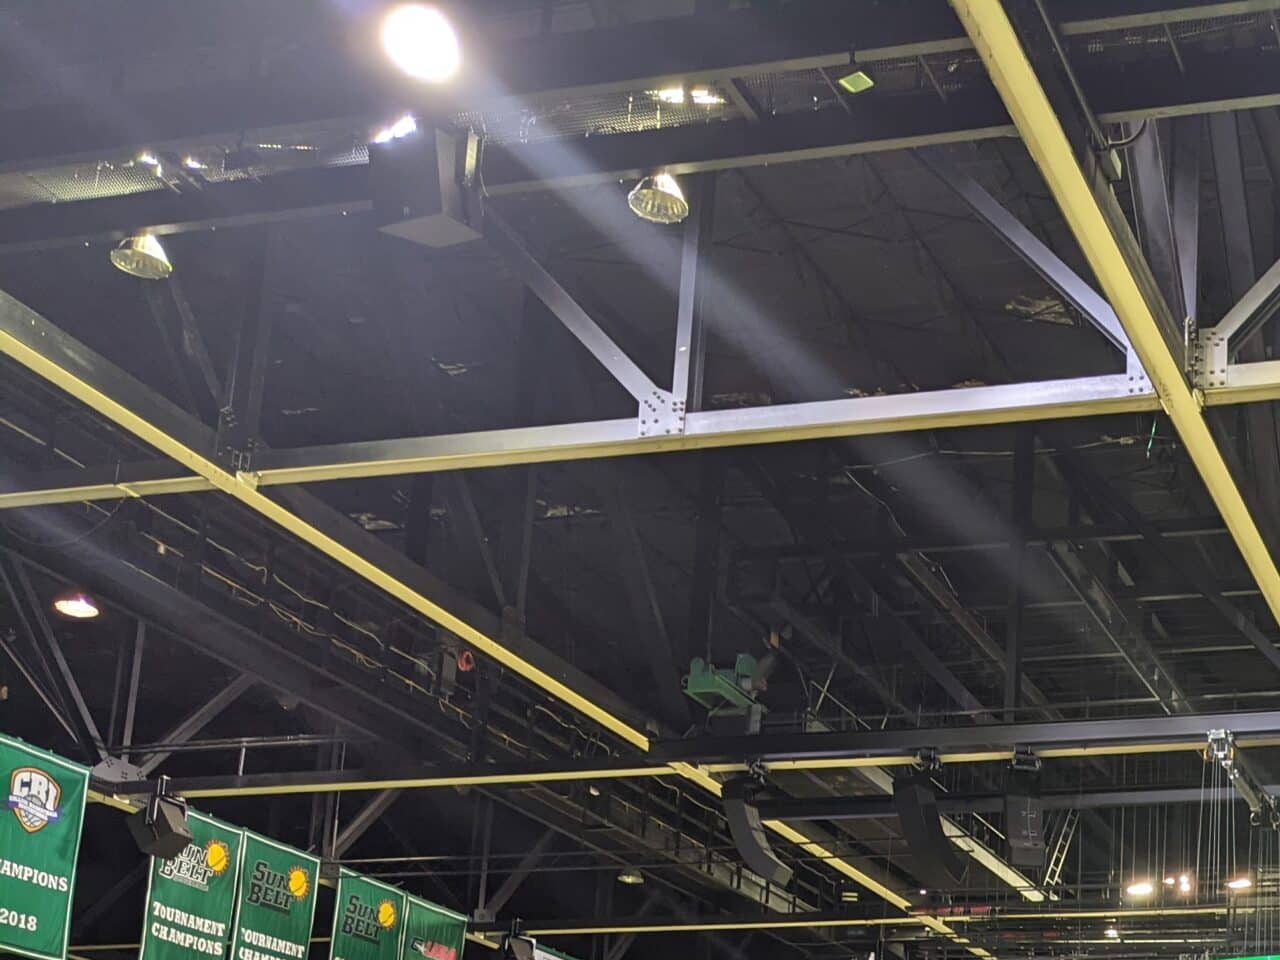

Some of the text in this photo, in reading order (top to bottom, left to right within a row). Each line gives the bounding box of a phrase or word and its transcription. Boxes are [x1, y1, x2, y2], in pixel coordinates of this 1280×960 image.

[14, 771, 57, 810] CBI
[179, 844, 209, 868] UN
[0, 859, 68, 892] AMPIONS
[160, 857, 214, 884] BELT
[254, 861, 290, 890] SUN
[248, 882, 292, 909] BELT
[347, 895, 380, 922] SUN
[0, 908, 37, 931] 2018
[153, 901, 225, 937] TOURNAMENT
[342, 914, 384, 940] BELT
[152, 922, 223, 956] CHAMPIONS
